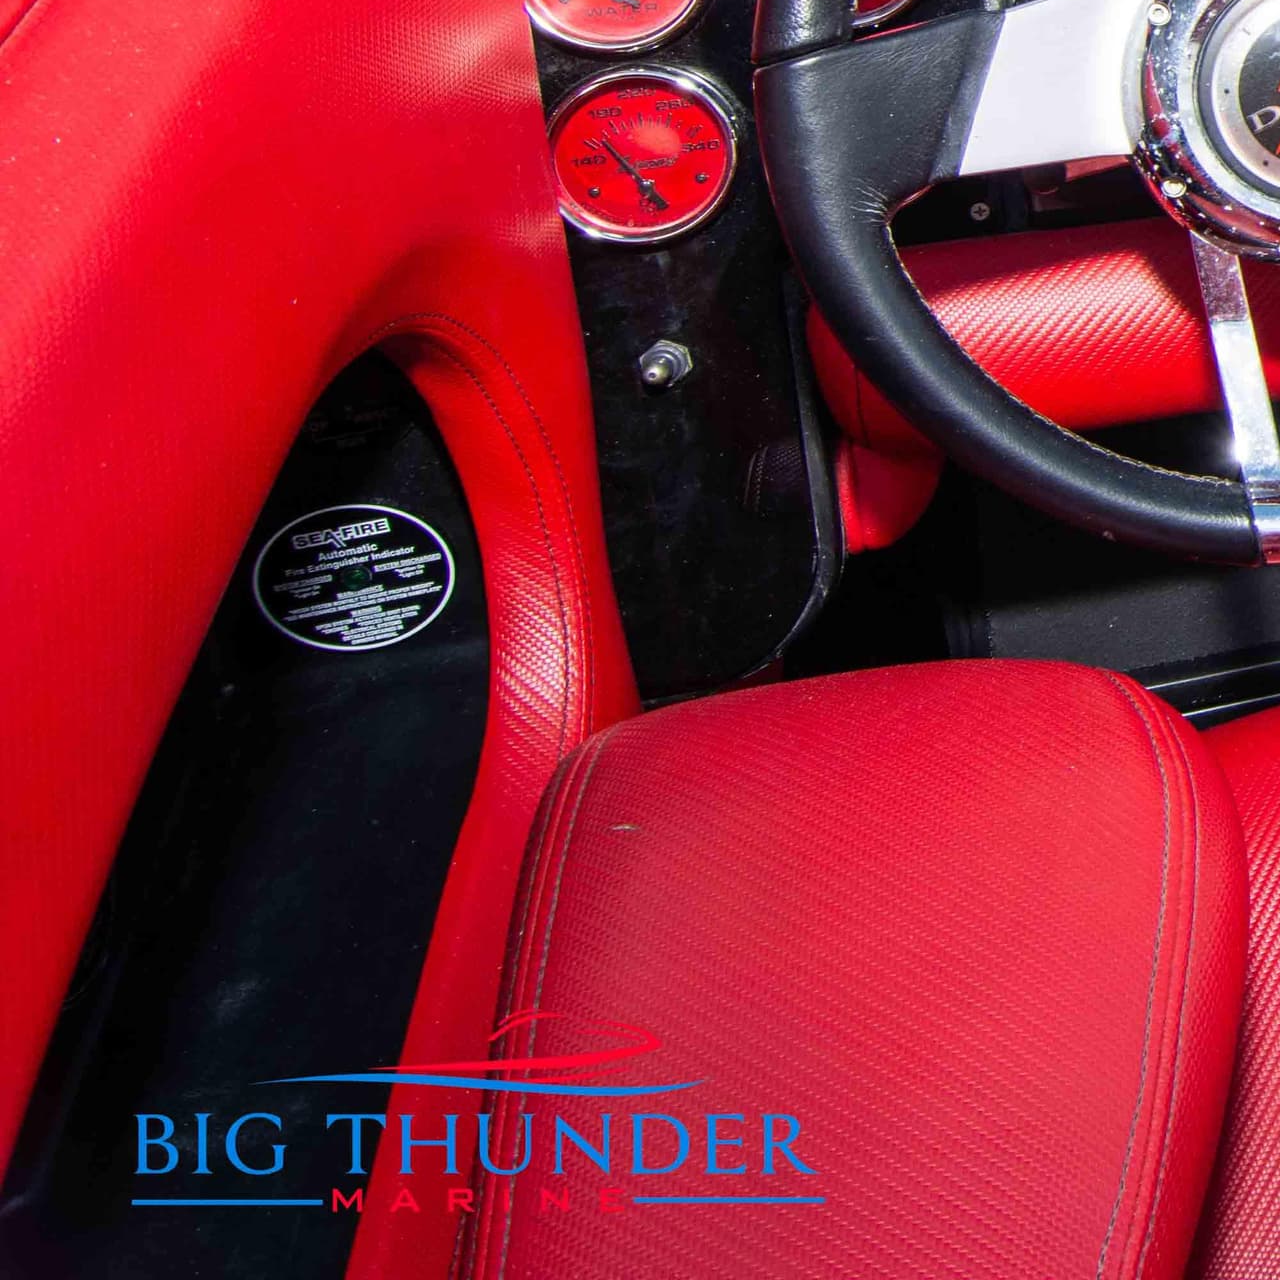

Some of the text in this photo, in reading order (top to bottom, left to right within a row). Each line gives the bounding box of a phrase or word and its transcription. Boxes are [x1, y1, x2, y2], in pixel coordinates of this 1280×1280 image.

[307, 555, 370, 573] Extinguisher
[371, 546, 415, 561] Indicator
[318, 543, 378, 561] Automatic
